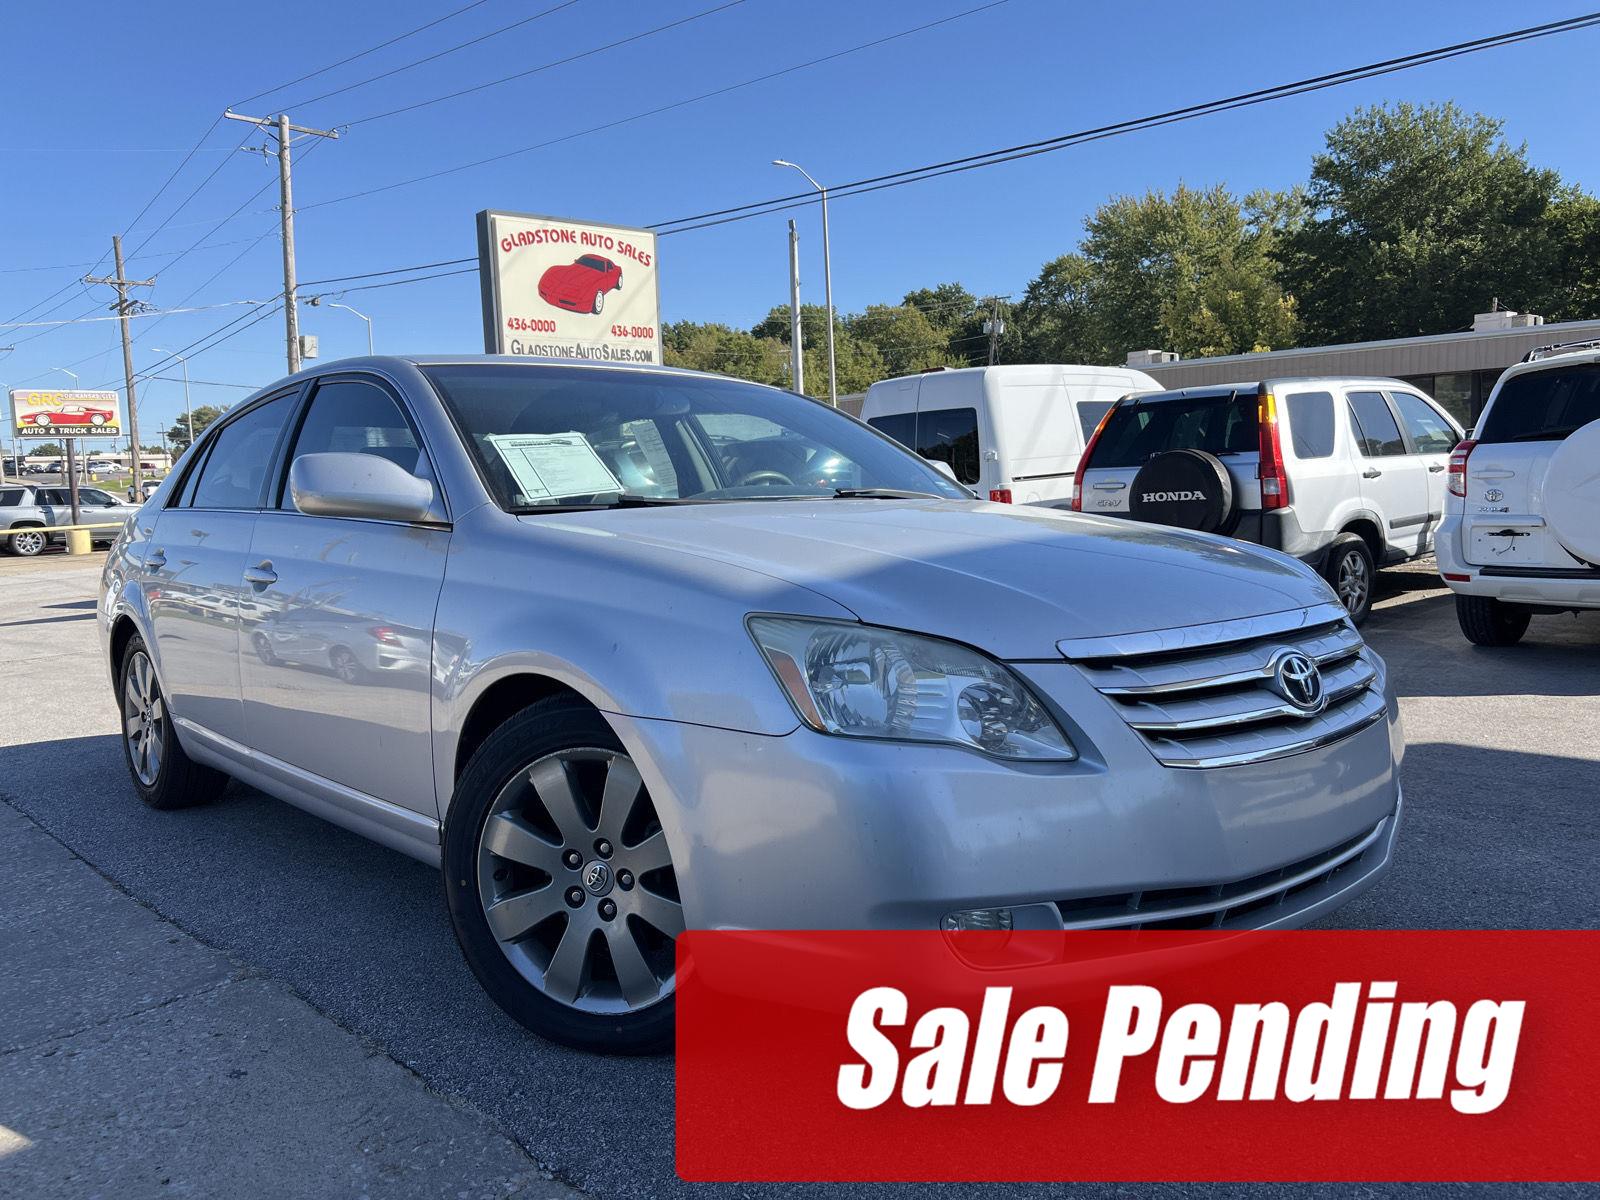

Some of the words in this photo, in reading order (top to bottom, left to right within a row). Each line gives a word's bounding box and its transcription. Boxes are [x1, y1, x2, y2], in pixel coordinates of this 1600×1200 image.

[501, 229, 576, 252] GLADSTONE
[581, 231, 614, 250] AUTO
[617, 241, 652, 267] SALES
[507, 317, 556, 332] 436-0000
[611, 324, 654, 339] 436-0000
[27, 392, 63, 406] GRC
[1142, 490, 1207, 503] HONDA
